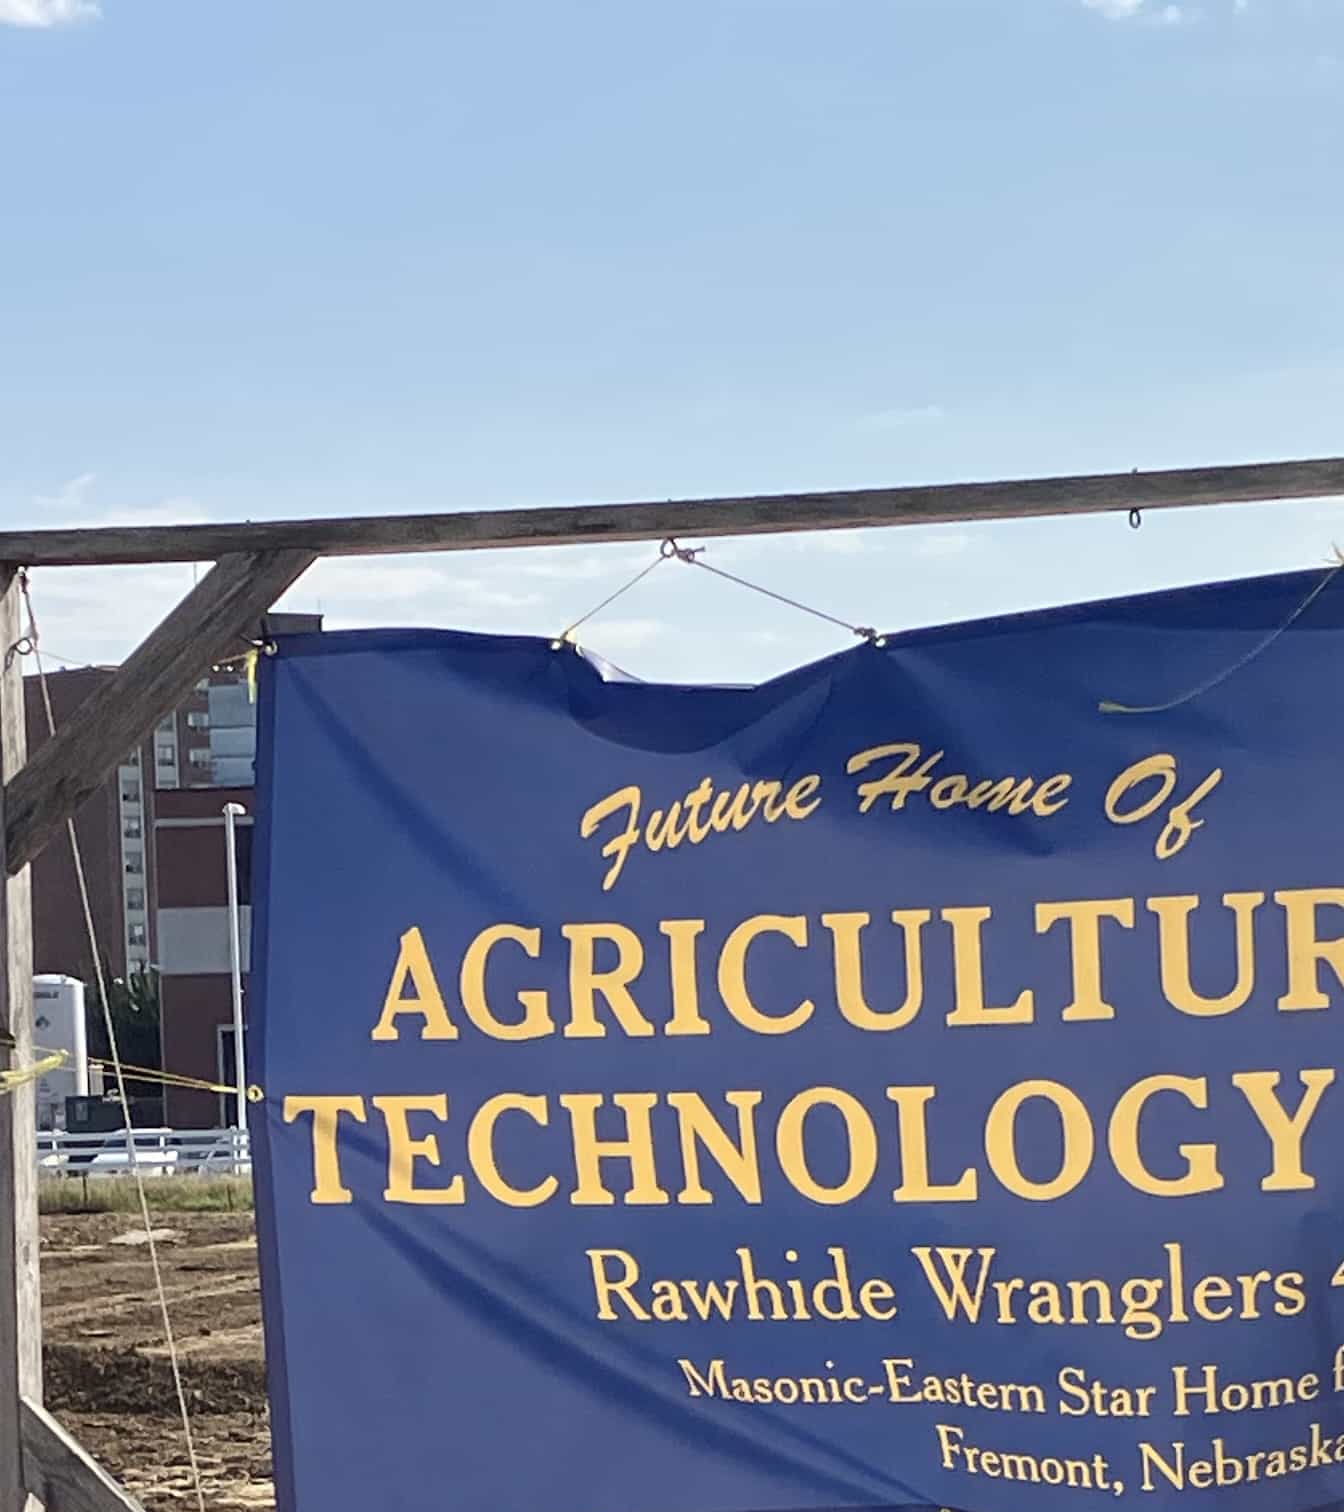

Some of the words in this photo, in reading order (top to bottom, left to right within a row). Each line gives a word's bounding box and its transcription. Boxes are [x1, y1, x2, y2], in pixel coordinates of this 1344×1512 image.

[580, 774, 821, 891] Future
[846, 743, 1073, 817] Home
[1104, 752, 1223, 860] Of
[283, 1067, 1336, 1208] TECHNOLOGY
[586, 1246, 898, 1322] Rawhide
[912, 1241, 1307, 1341] Wranglers
[678, 1358, 1045, 1414] Masonic-Eastern
[1058, 1366, 1156, 1418] Star
[1173, 1364, 1319, 1417] Home
[936, 1423, 1124, 1497] Fremont,
